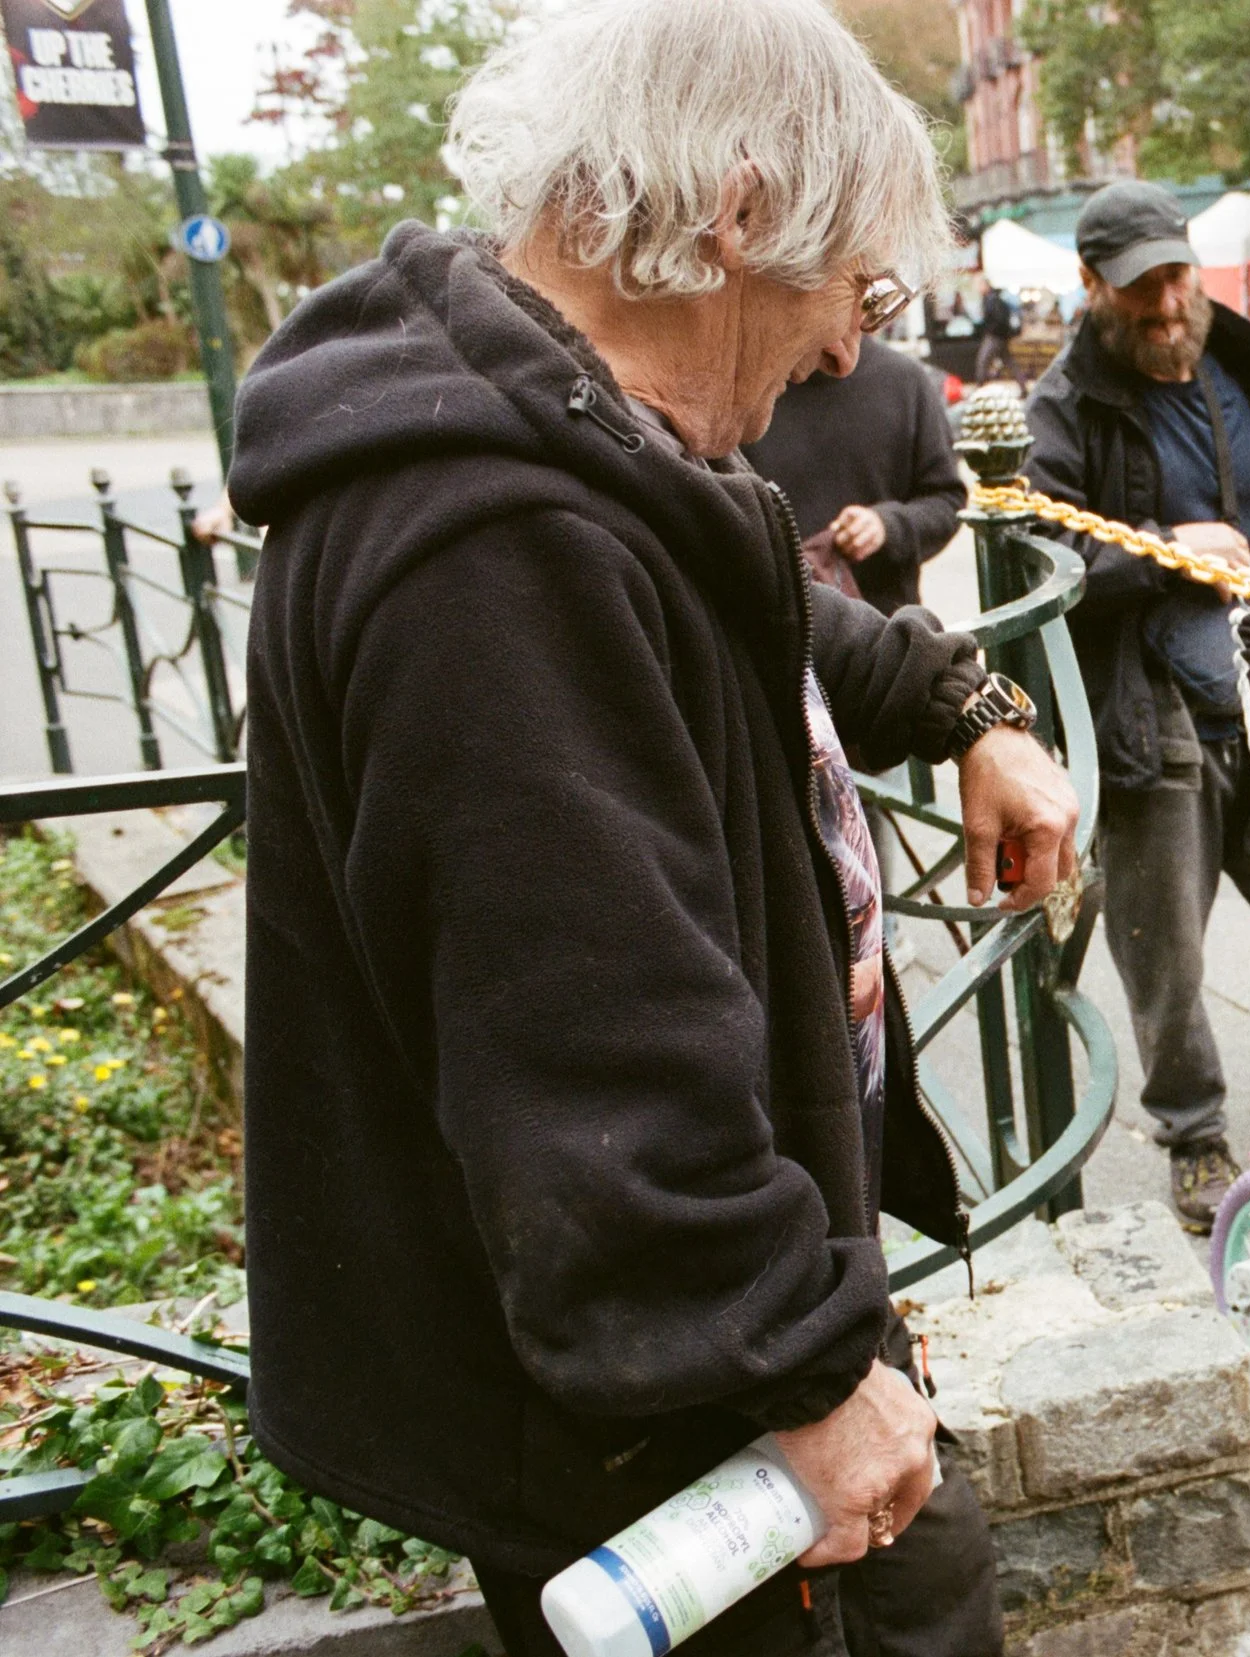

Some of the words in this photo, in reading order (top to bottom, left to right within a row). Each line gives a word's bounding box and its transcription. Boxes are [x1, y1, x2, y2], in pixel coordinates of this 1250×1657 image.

[29, 27, 67, 67] UP
[64, 30, 117, 70] THE
[20, 63, 136, 107] CHERRIES
[705, 1510, 740, 1557] ALCOHOL
[711, 1500, 751, 1554] ISOPROPYL
